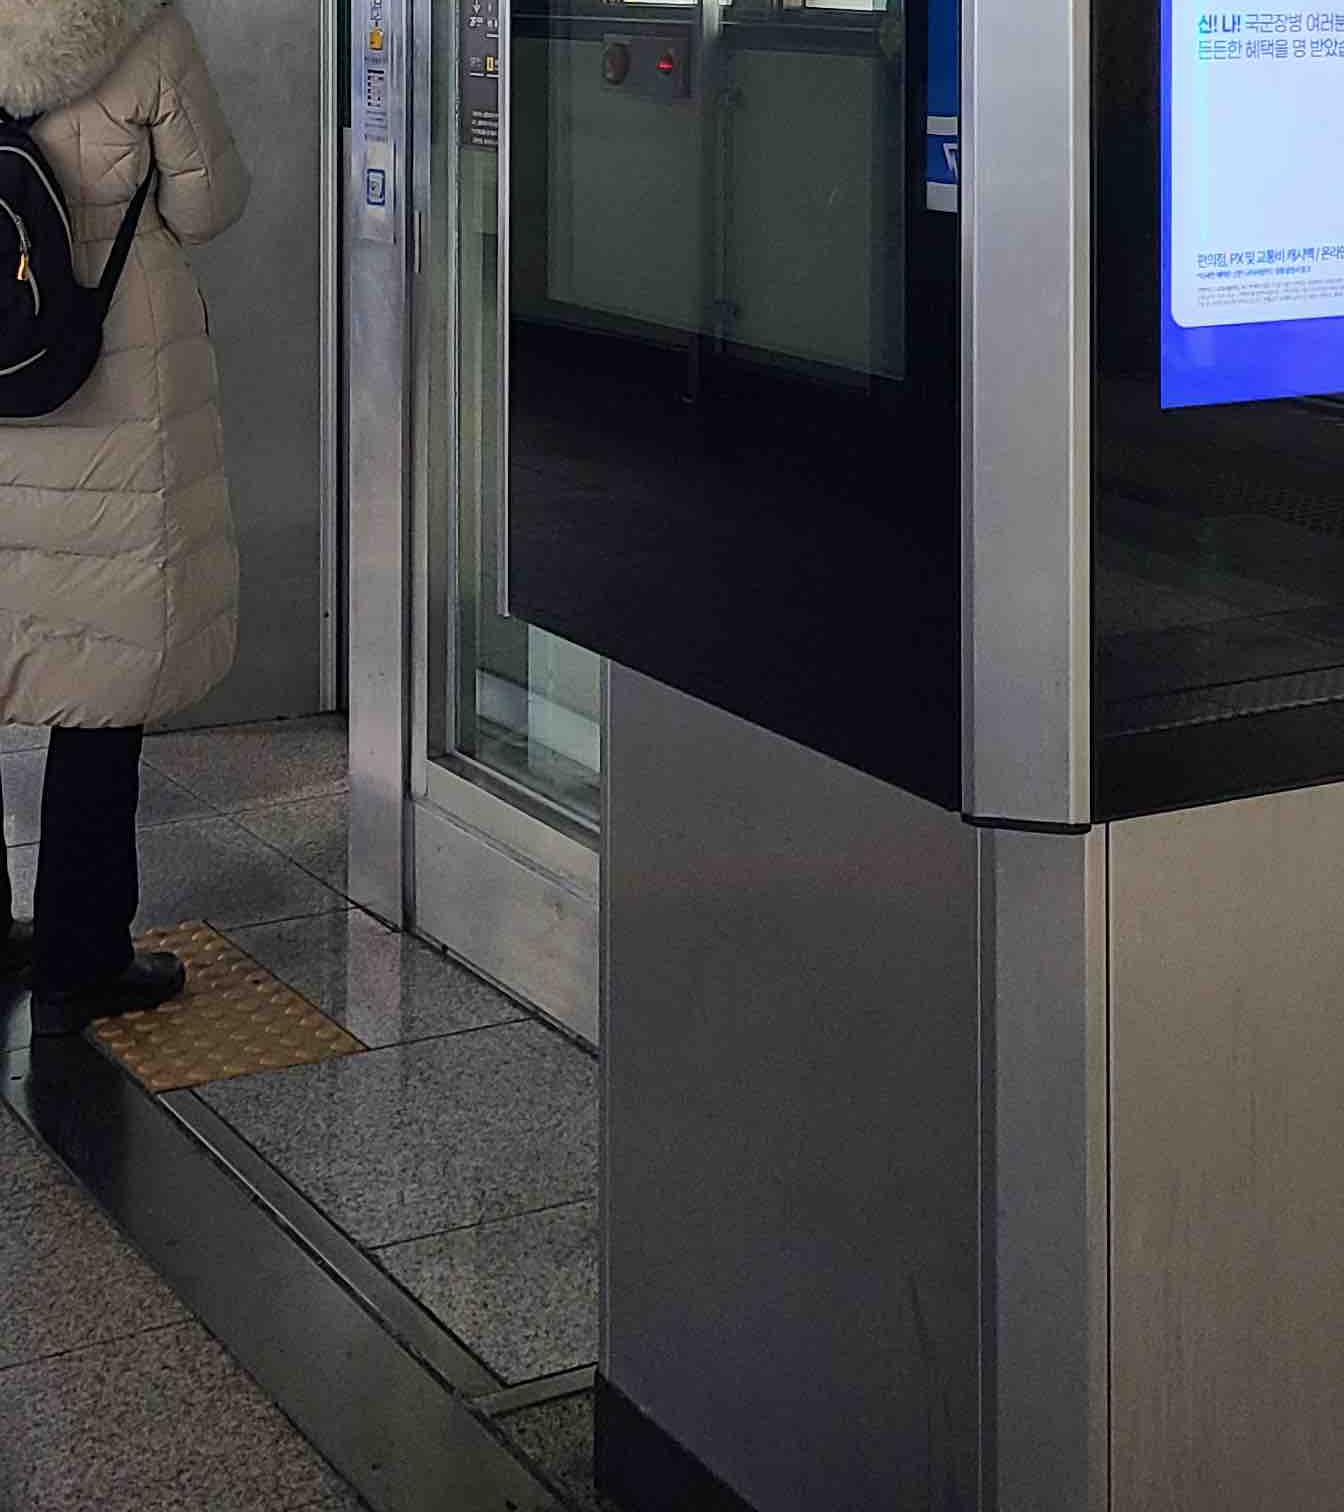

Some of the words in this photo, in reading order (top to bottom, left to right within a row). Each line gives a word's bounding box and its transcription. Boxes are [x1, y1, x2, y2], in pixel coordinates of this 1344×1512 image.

[1198, 13, 1218, 33] 신!
[1221, 13, 1241, 33] 나!
[1245, 13, 1302, 33] 국군장병
[1198, 39, 1243, 60] 든든한
[1245, 39, 1289, 60] 혜택을
[1292, 39, 1306, 59] 명
